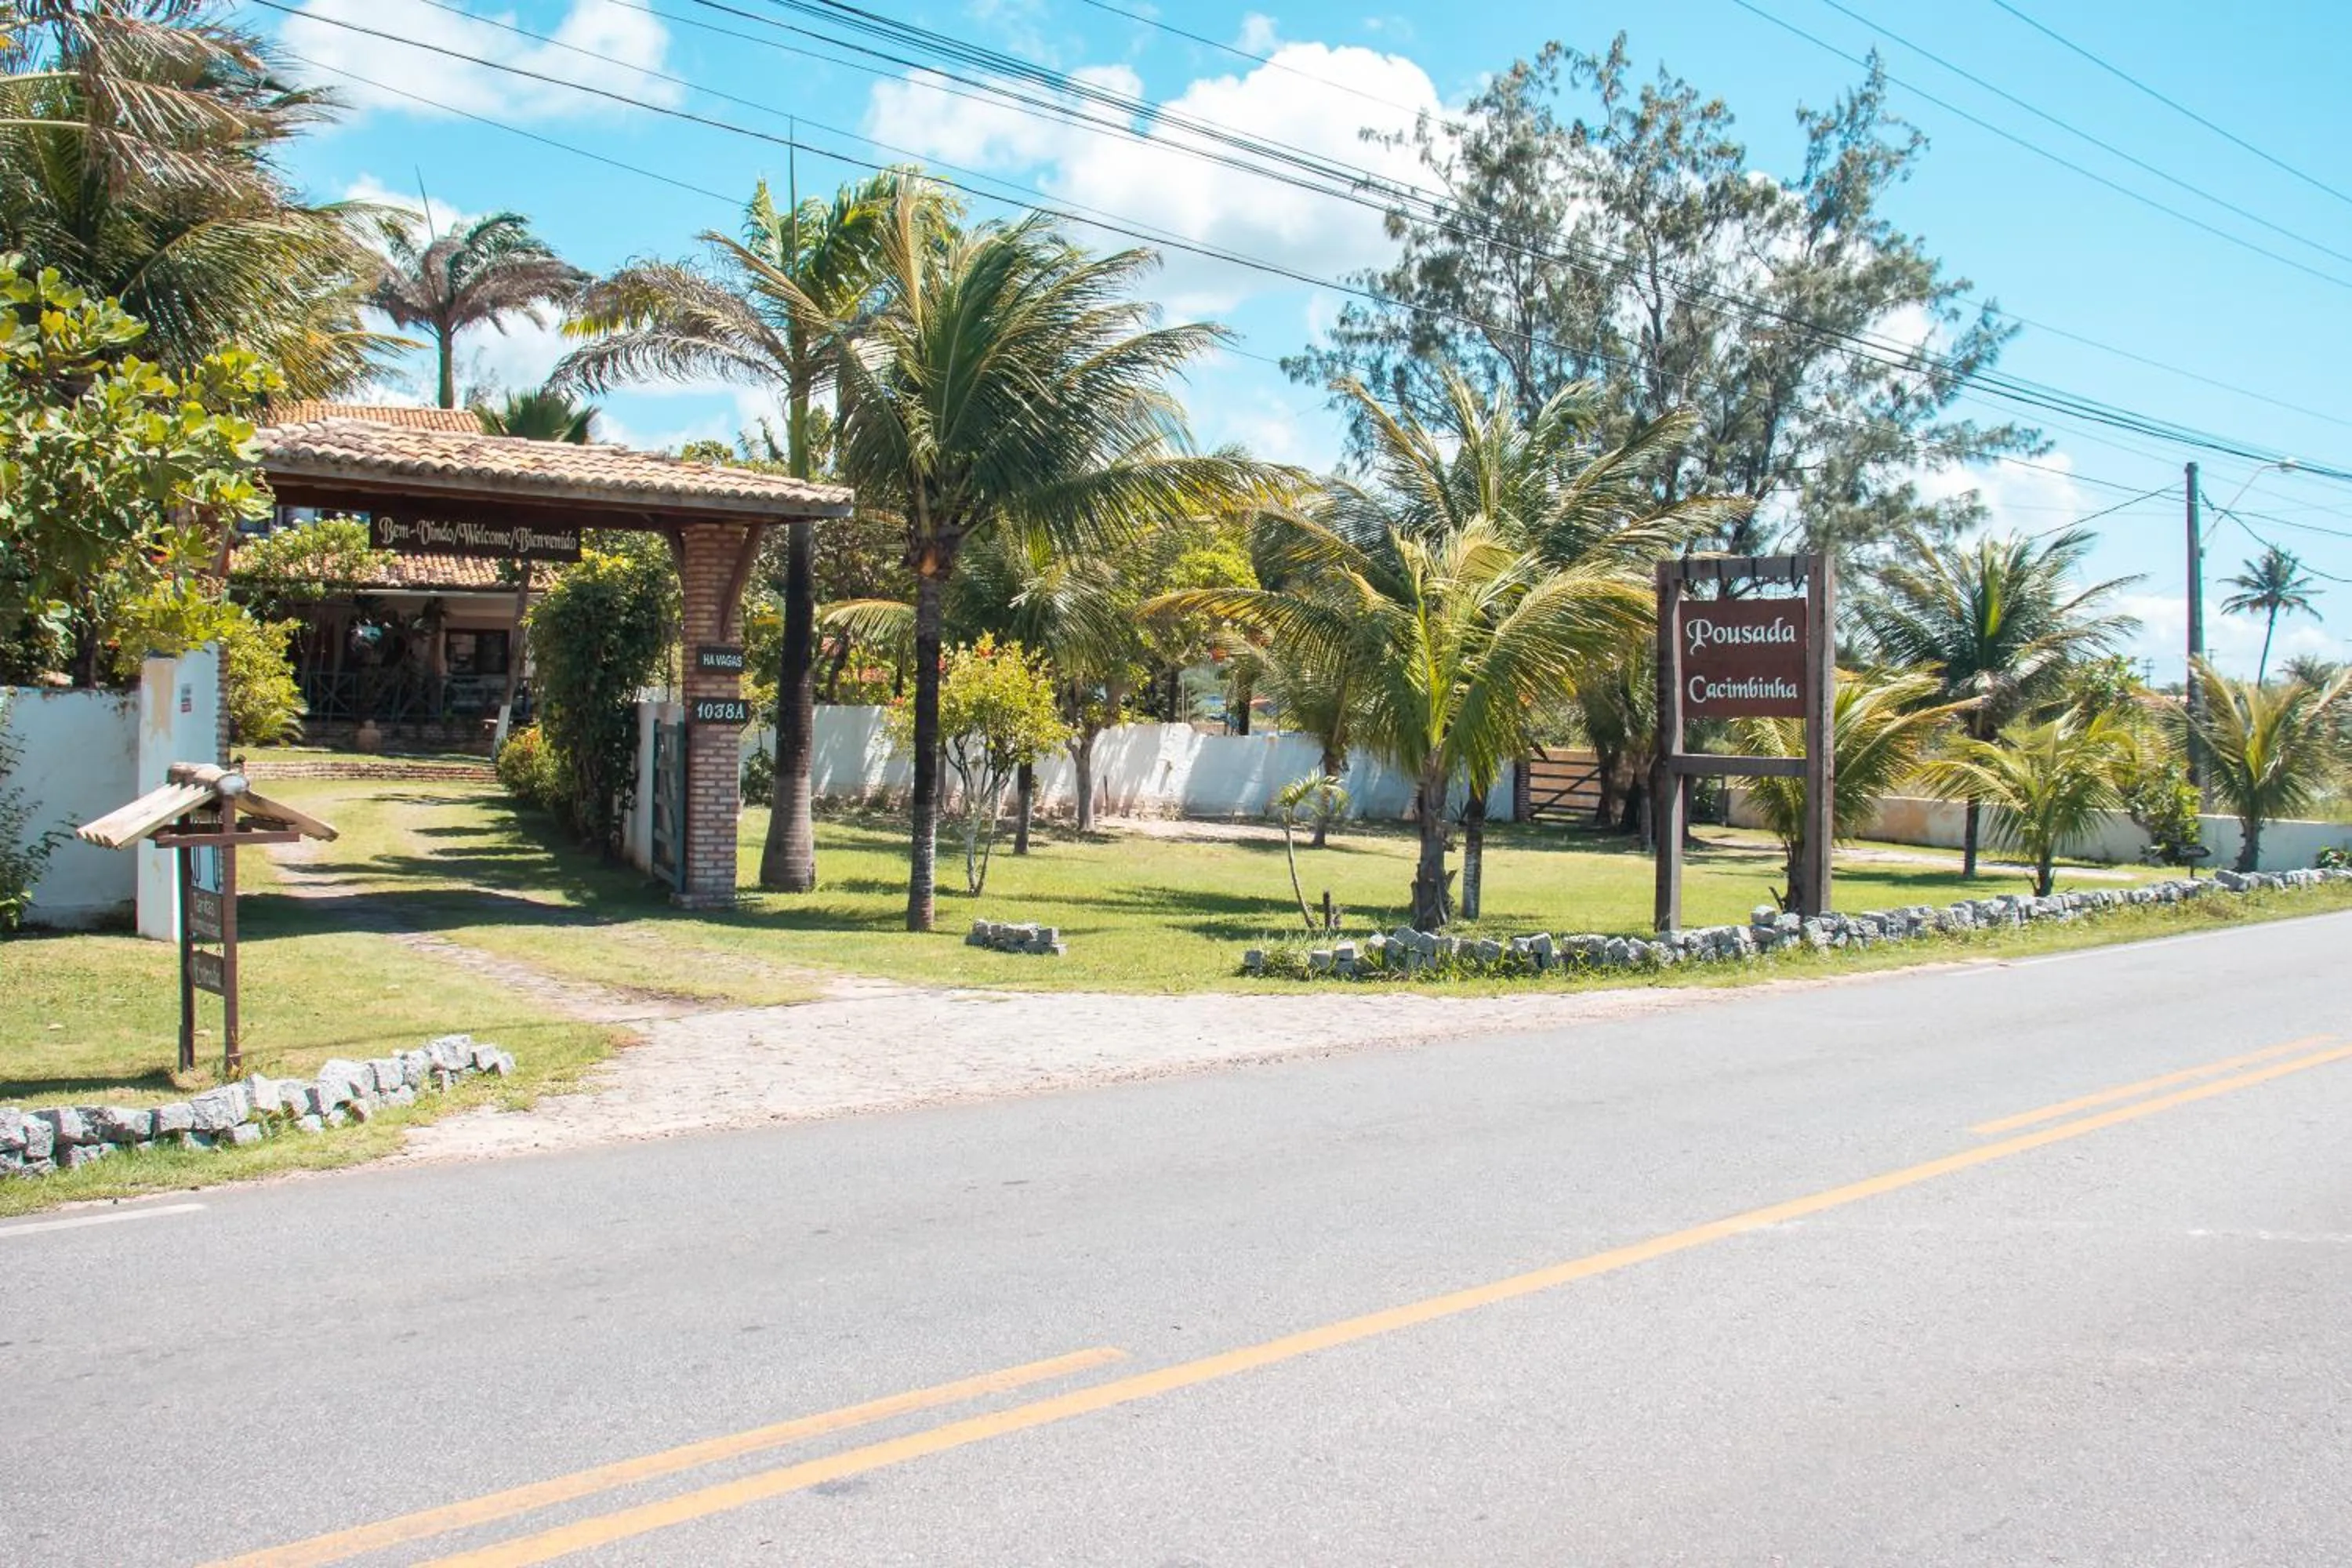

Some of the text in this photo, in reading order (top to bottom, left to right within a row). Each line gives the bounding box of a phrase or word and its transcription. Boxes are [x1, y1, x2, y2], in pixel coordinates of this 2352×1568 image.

[1686, 617, 1796, 655] Pousada
[716, 655, 742, 667] VAGAS
[1689, 675, 1798, 703] Cacimbinha
